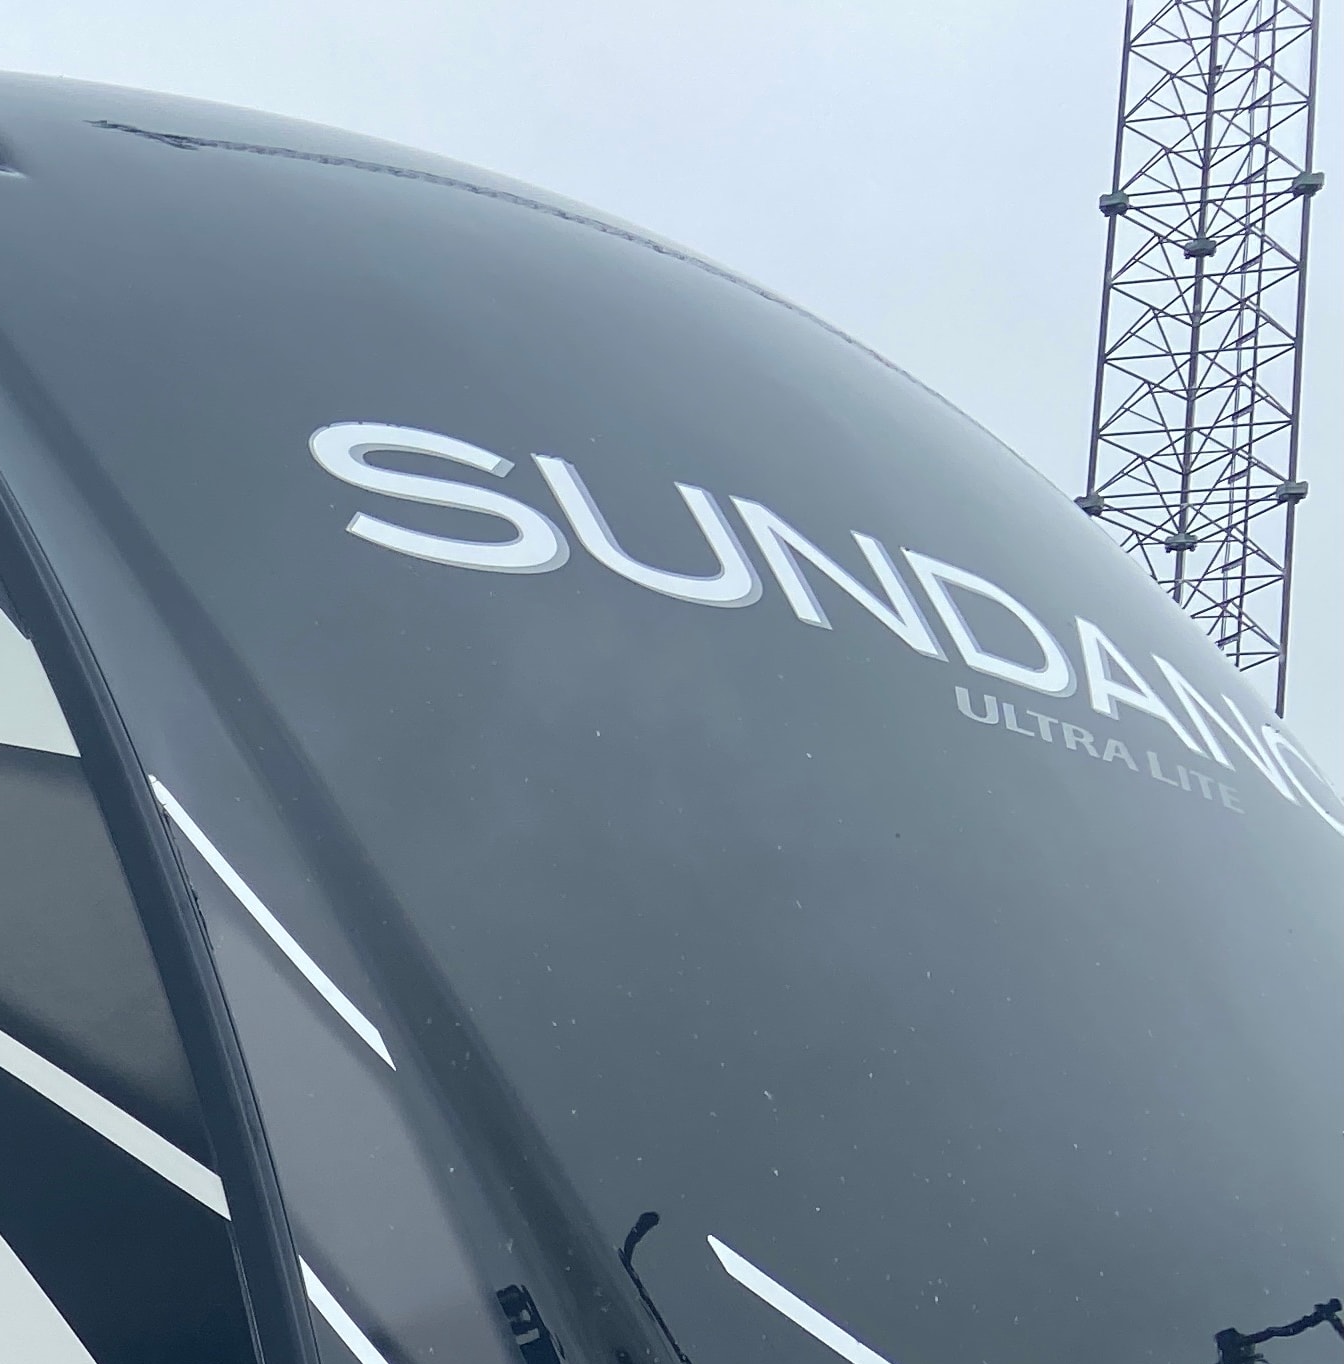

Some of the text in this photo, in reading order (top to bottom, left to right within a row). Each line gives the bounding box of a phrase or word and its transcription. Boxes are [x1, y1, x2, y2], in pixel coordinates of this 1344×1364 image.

[309, 421, 1344, 838] SUNDANC
[954, 686, 1246, 815] ULTRA LITE
